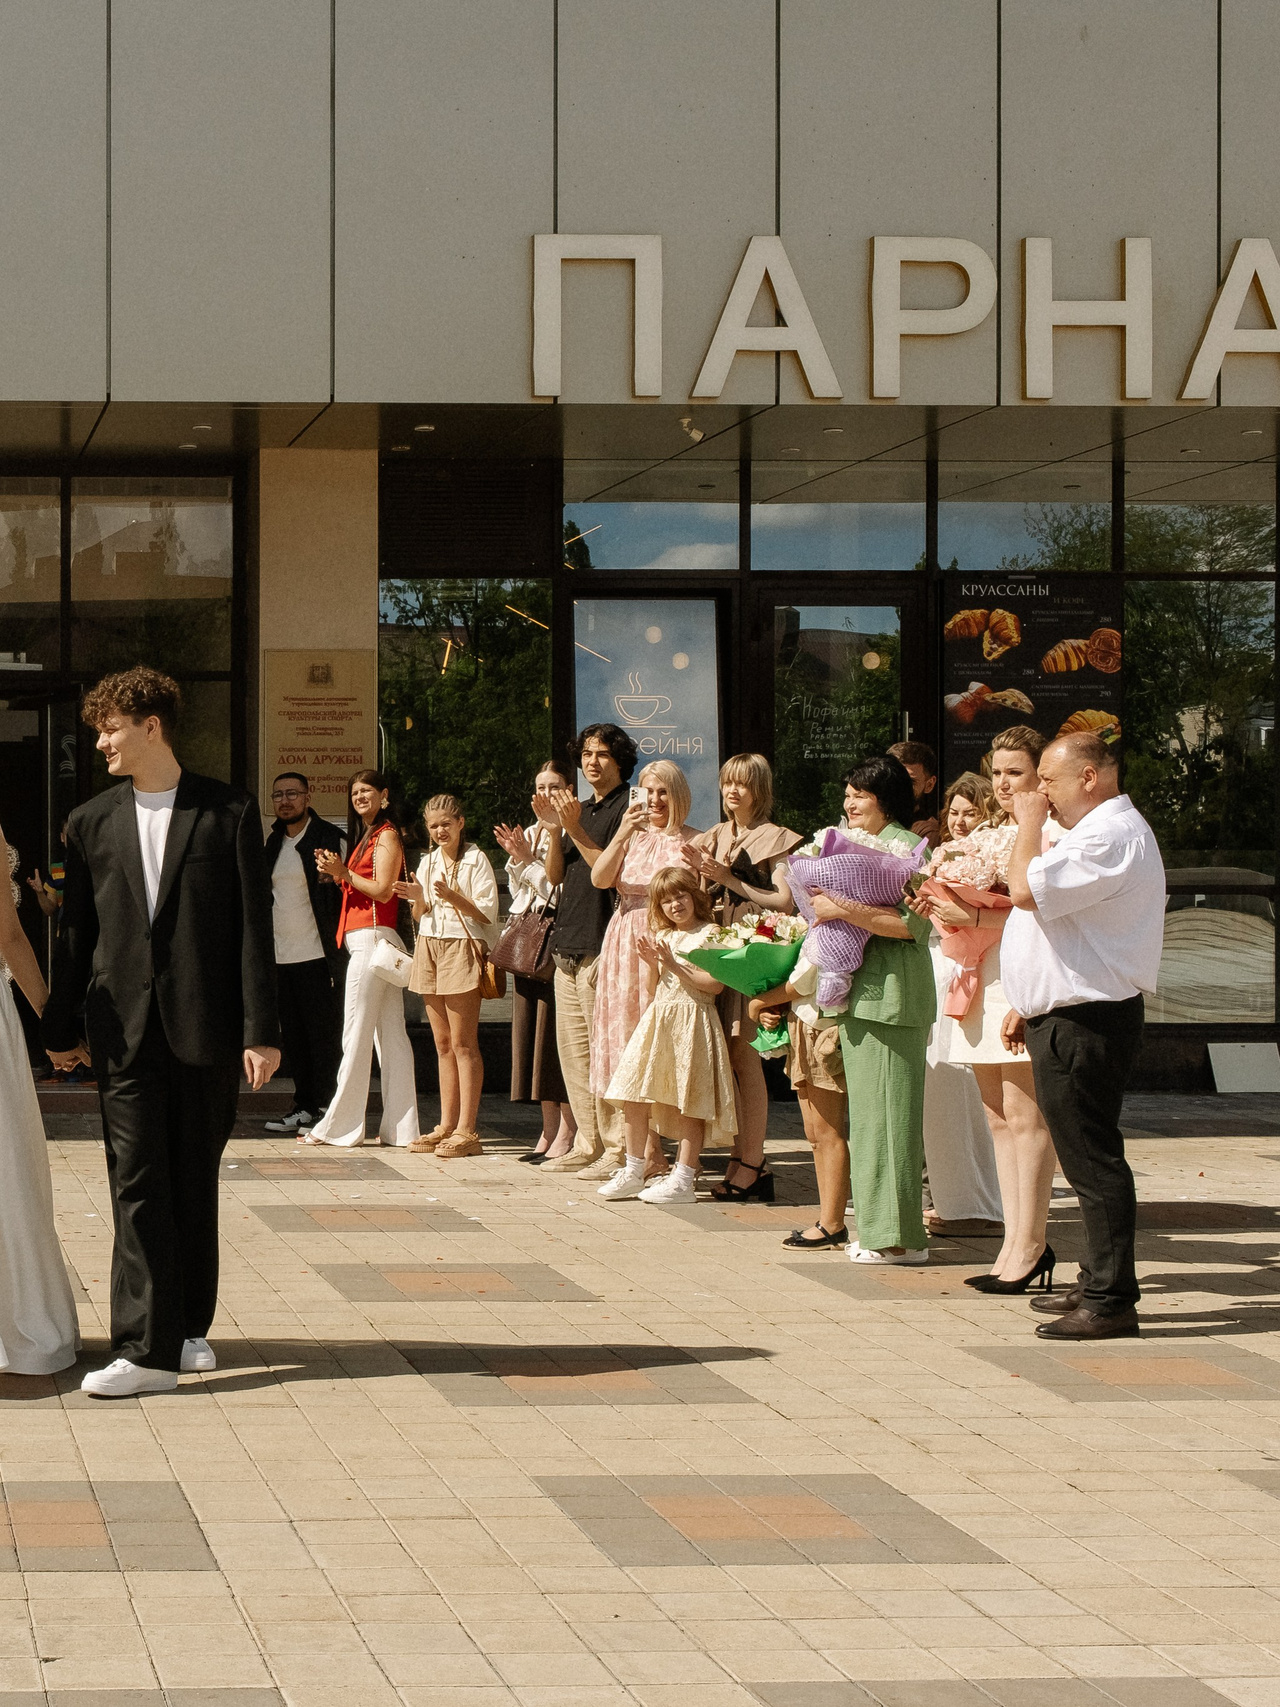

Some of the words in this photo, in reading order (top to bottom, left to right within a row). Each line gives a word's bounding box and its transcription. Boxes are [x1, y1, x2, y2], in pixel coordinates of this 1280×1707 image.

[531, 233, 1280, 401] ПАРНА
[961, 584, 1049, 597] КРУАССАНЫ
[628, 731, 703, 754] ейня
[277, 755, 307, 765] ДОМ
[312, 755, 363, 765] ДРУЖБЫ
[309, 784, 348, 793] 0-21:00
